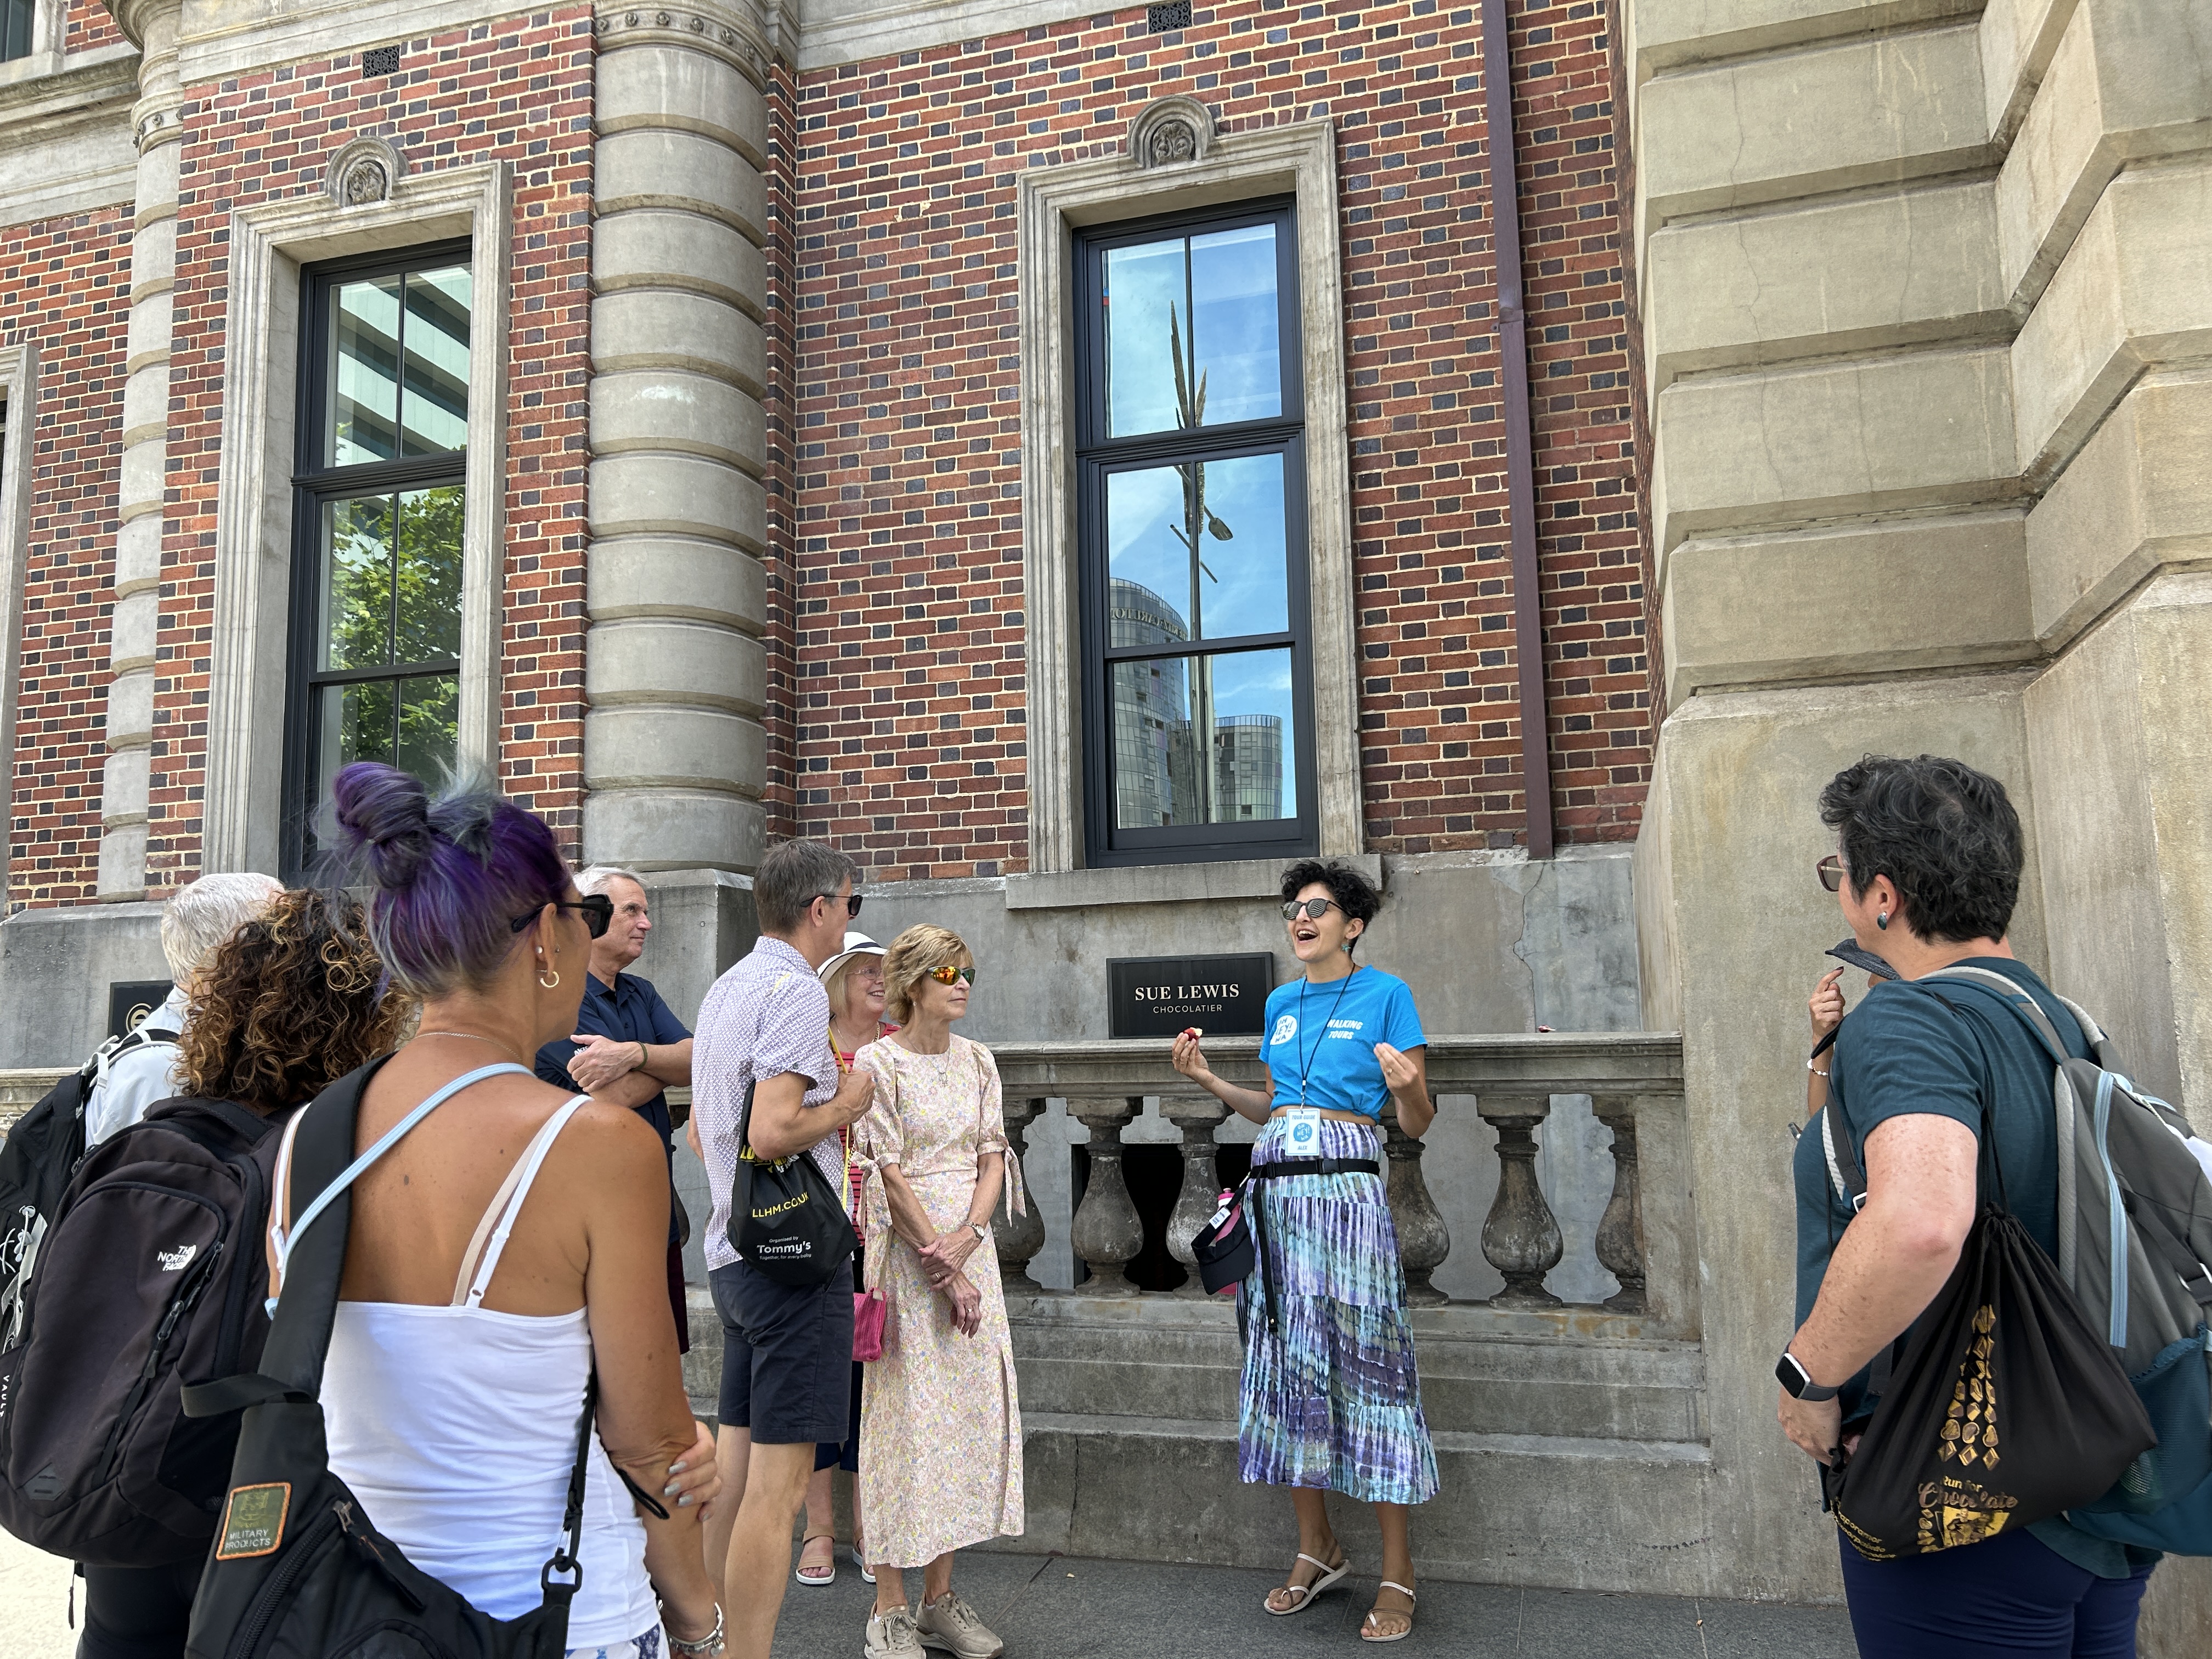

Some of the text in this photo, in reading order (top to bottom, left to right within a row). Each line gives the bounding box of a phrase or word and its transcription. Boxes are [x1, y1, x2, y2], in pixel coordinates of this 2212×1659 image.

[1135, 984, 1239, 1001] SUE LEWIS
[1153, 1005, 1222, 1013] CHOCOLATIER
[1327, 1019, 1363, 1030] WALKING
[1328, 1030, 1354, 1040] TOURS
[752, 1192, 809, 1217] LLHM.CO.UK
[757, 1240, 811, 1254] Tommy's
[229, 1528, 269, 1541] MILITARY
[224, 1538, 271, 1551] PRODUCTS
